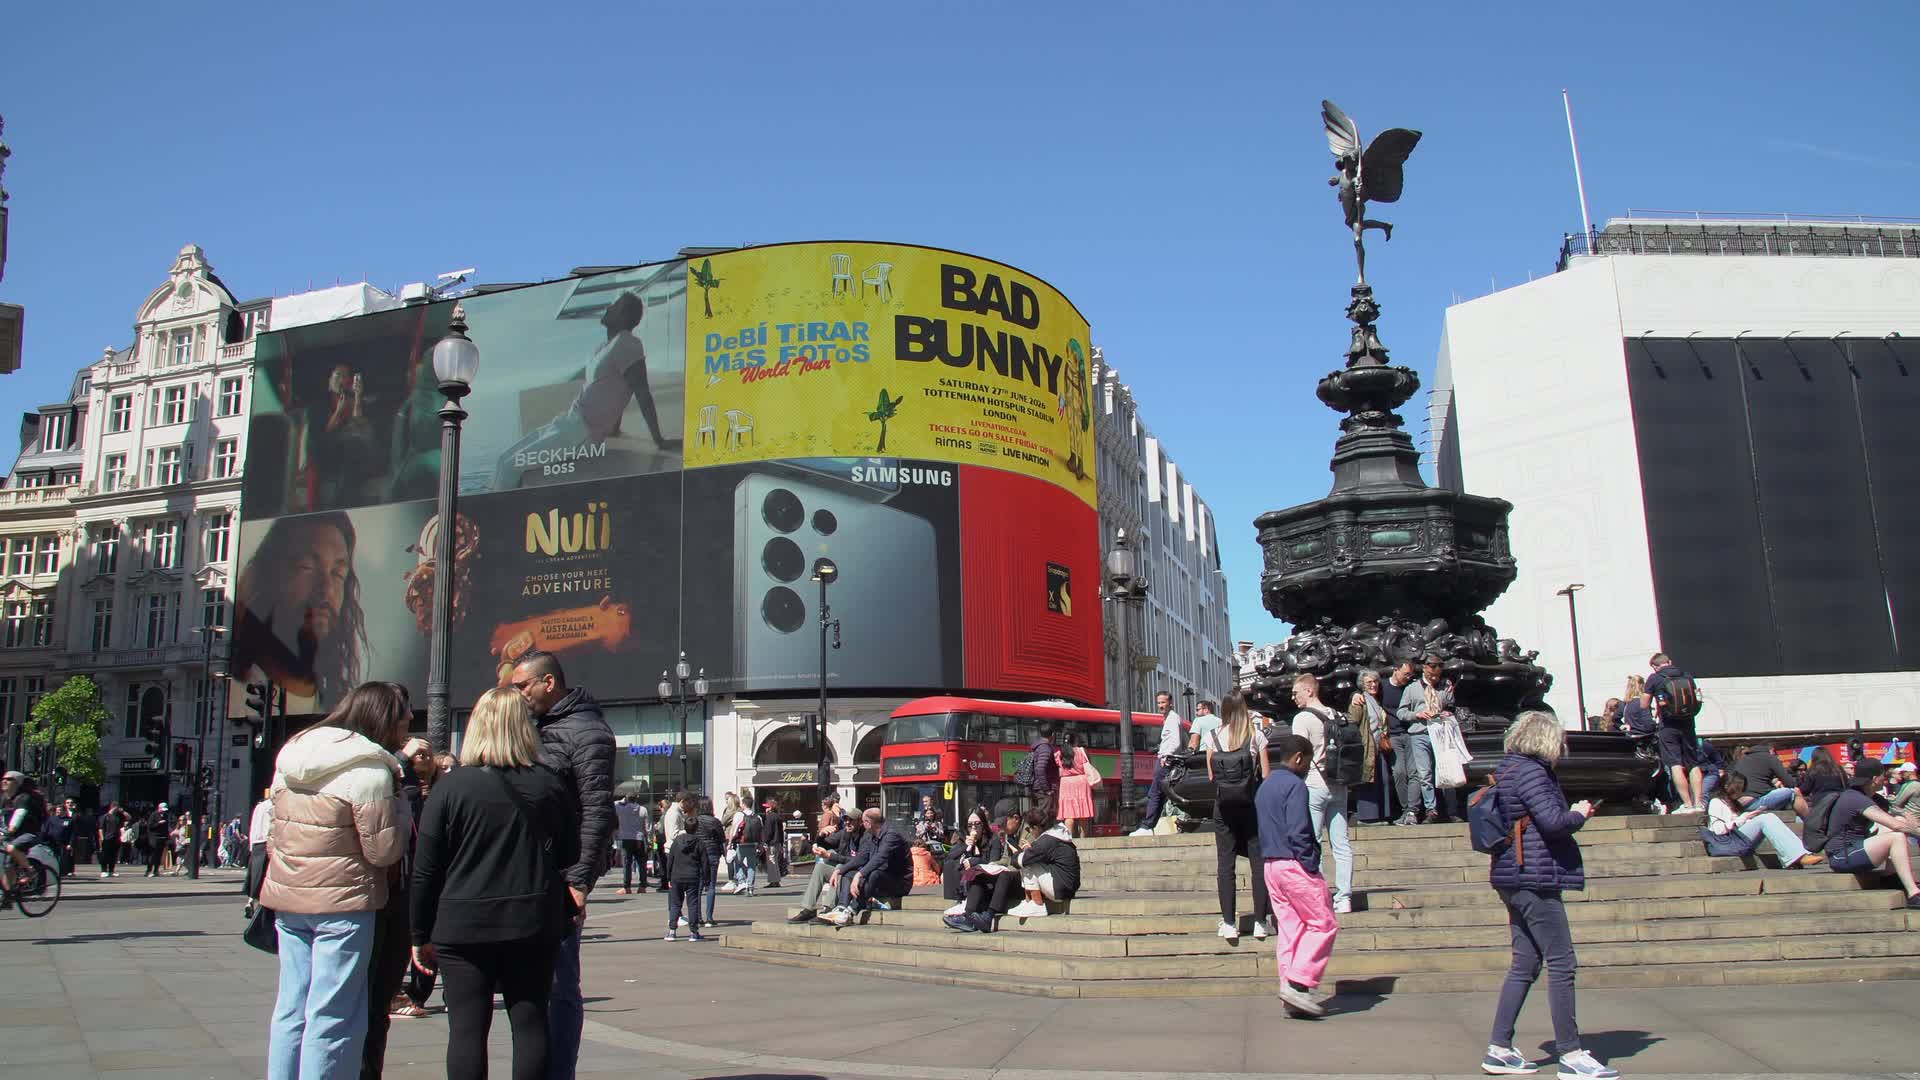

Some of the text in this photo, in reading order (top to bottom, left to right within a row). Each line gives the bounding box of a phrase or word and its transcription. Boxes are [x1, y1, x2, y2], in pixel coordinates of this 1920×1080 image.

[941, 263, 1040, 330] BAD
[895, 314, 1063, 396] BUNNY
[740, 356, 832, 384] World Tour
[939, 378, 990, 394] SATURDAY
[1010, 391, 1029, 404] JUNE
[1029, 397, 1046, 410] 2026
[924, 388, 1055, 425] TOTTENHAM HOTSPUR STADIUM
[983, 408, 1017, 422] LONDON
[929, 423, 967, 435] TICKETS
[969, 429, 980, 437] GO
[982, 431, 994, 439] ON
[995, 433, 1015, 444] SALE
[1015, 436, 1039, 451] FRIDAY
[514, 441, 606, 467] BECKHAM
[1003, 447, 1020, 459] LIVE
[1022, 452, 1049, 467] NATION
[543, 462, 575, 476] BOSS
[851, 466, 952, 487] SAMSUNG
[526, 568, 608, 582] CHOOSE YOUR NEXT
[522, 577, 612, 596] ADVENTURE
[540, 622, 594, 634] AUSTRALIAN
[628, 741, 675, 757] beauty
[977, 761, 996, 769] ARRIVA
[779, 770, 806, 782] Lindt
